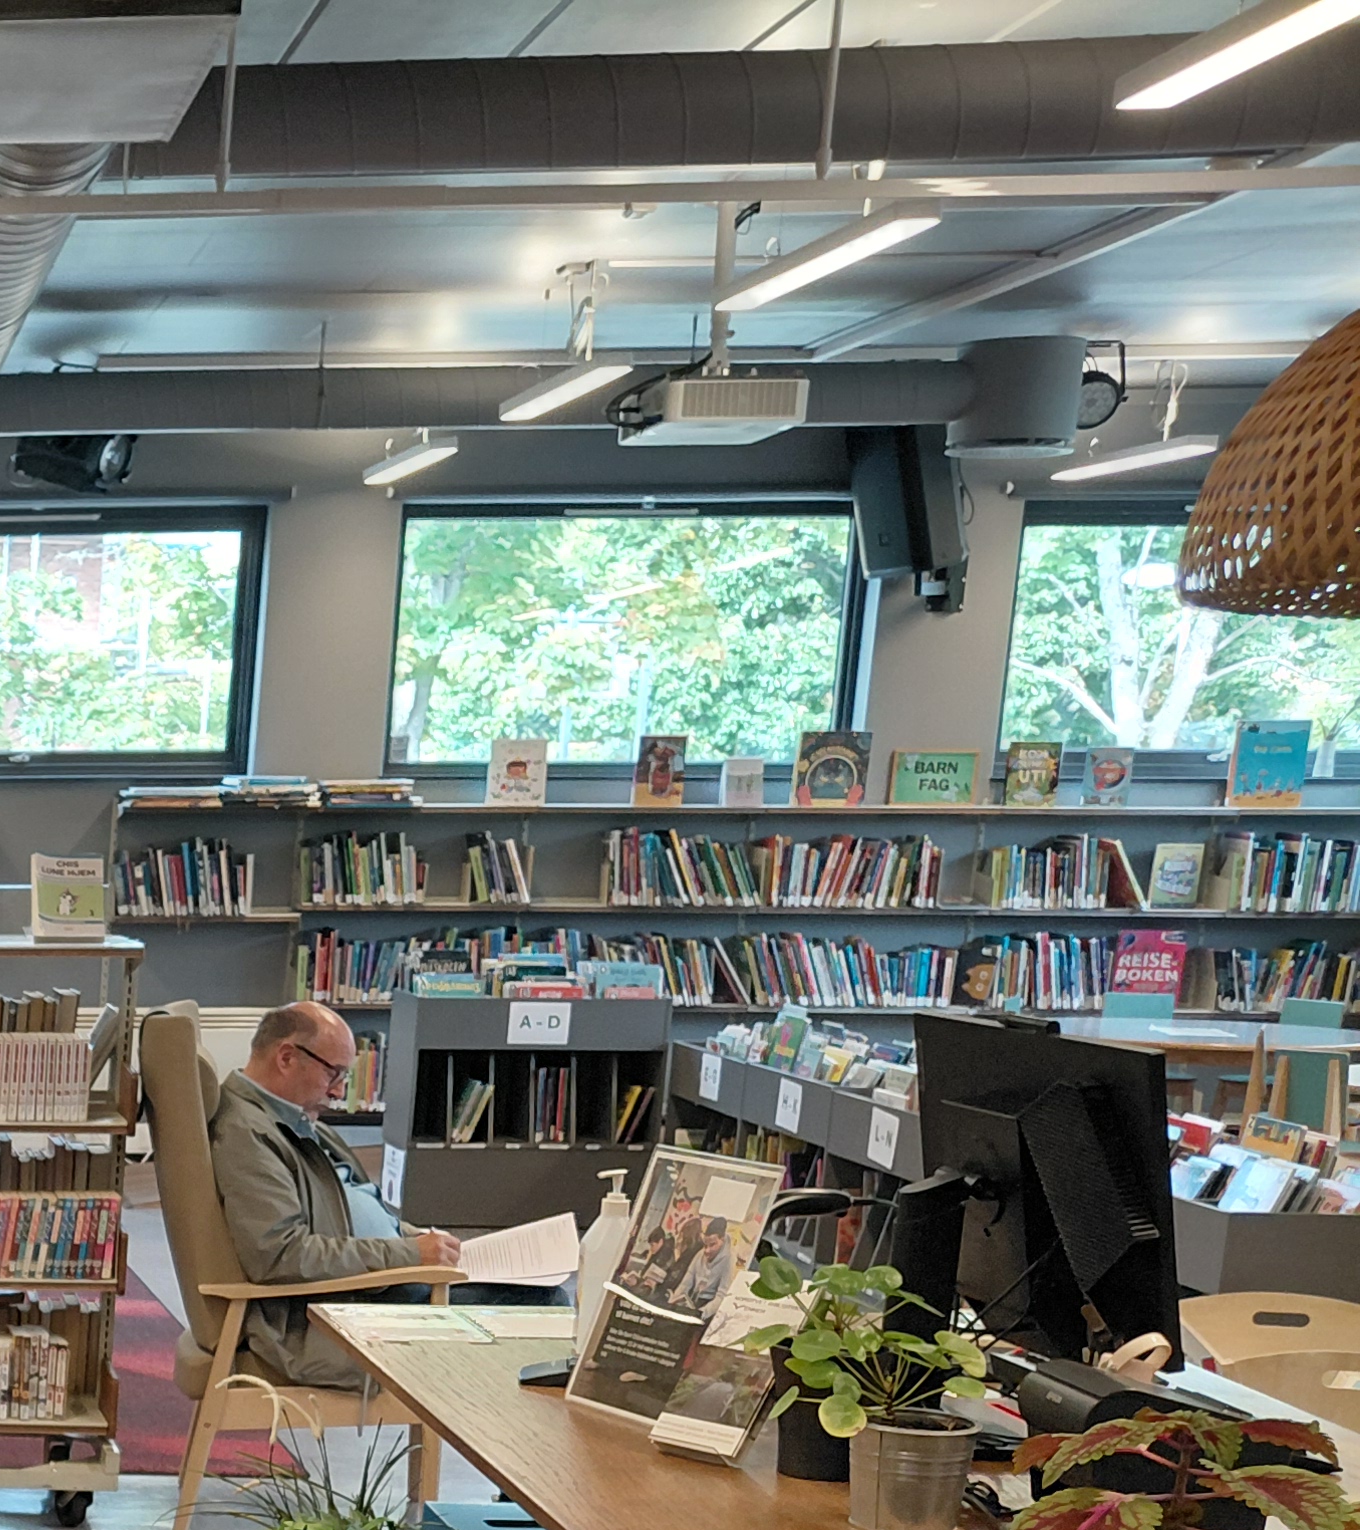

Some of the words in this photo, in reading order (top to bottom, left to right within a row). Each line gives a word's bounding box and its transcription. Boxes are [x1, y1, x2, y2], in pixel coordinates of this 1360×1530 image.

[914, 760, 959, 774] BARN
[918, 778, 950, 791] FAG
[1118, 951, 1178, 968] REISE-
[1114, 968, 1179, 983] BOKEN
[519, 1015, 532, 1029] A
[548, 1015, 561, 1029] D
